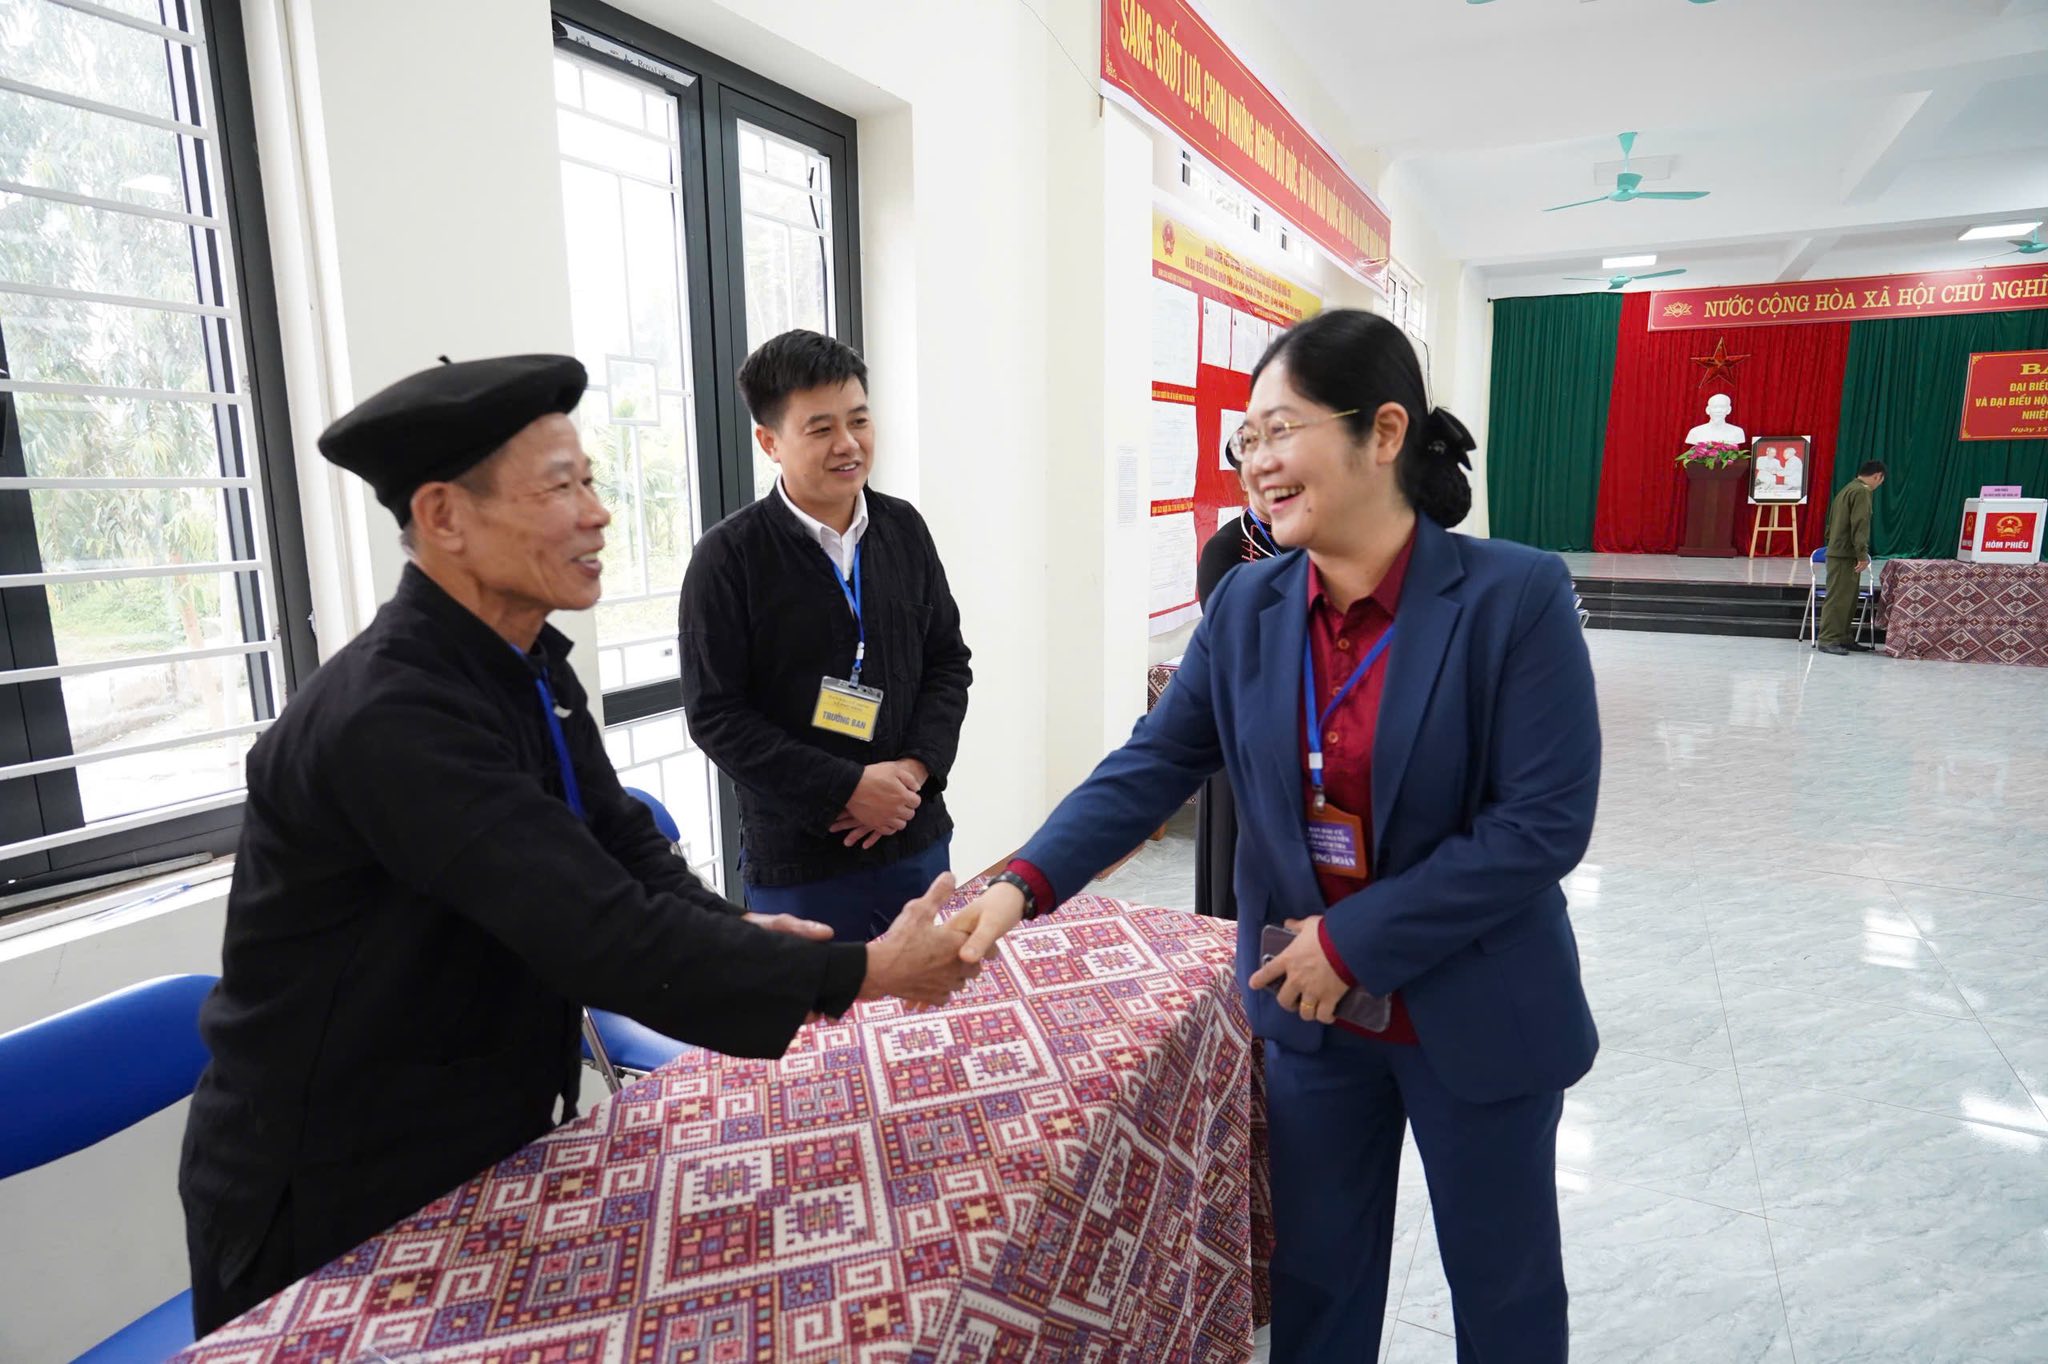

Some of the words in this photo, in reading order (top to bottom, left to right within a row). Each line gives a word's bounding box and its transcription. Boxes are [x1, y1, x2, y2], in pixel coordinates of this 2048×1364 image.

[1155, 20, 1182, 96] SUỐT
[1183, 50, 1202, 120] LỰA
[1203, 69, 1227, 141] CHỌN
[1228, 94, 1254, 159] NHỮNG
[1704, 294, 1754, 318] NƯỚC
[1758, 292, 1810, 318] CỘNG
[1814, 288, 1856, 311] HÒA
[1862, 285, 1892, 308] XÃ
[1897, 282, 1936, 310] HỘI
[1941, 275, 1986, 303] CHỦ
[2010, 382, 2027, 394] ĐẠI
[1975, 396, 1988, 407] VÀ
[1990, 397, 2007, 408] ĐẠI
[2008, 393, 2031, 406] BIỂU
[1985, 540, 2004, 549] HÒM
[2004, 539, 2029, 549] PHIẾU
